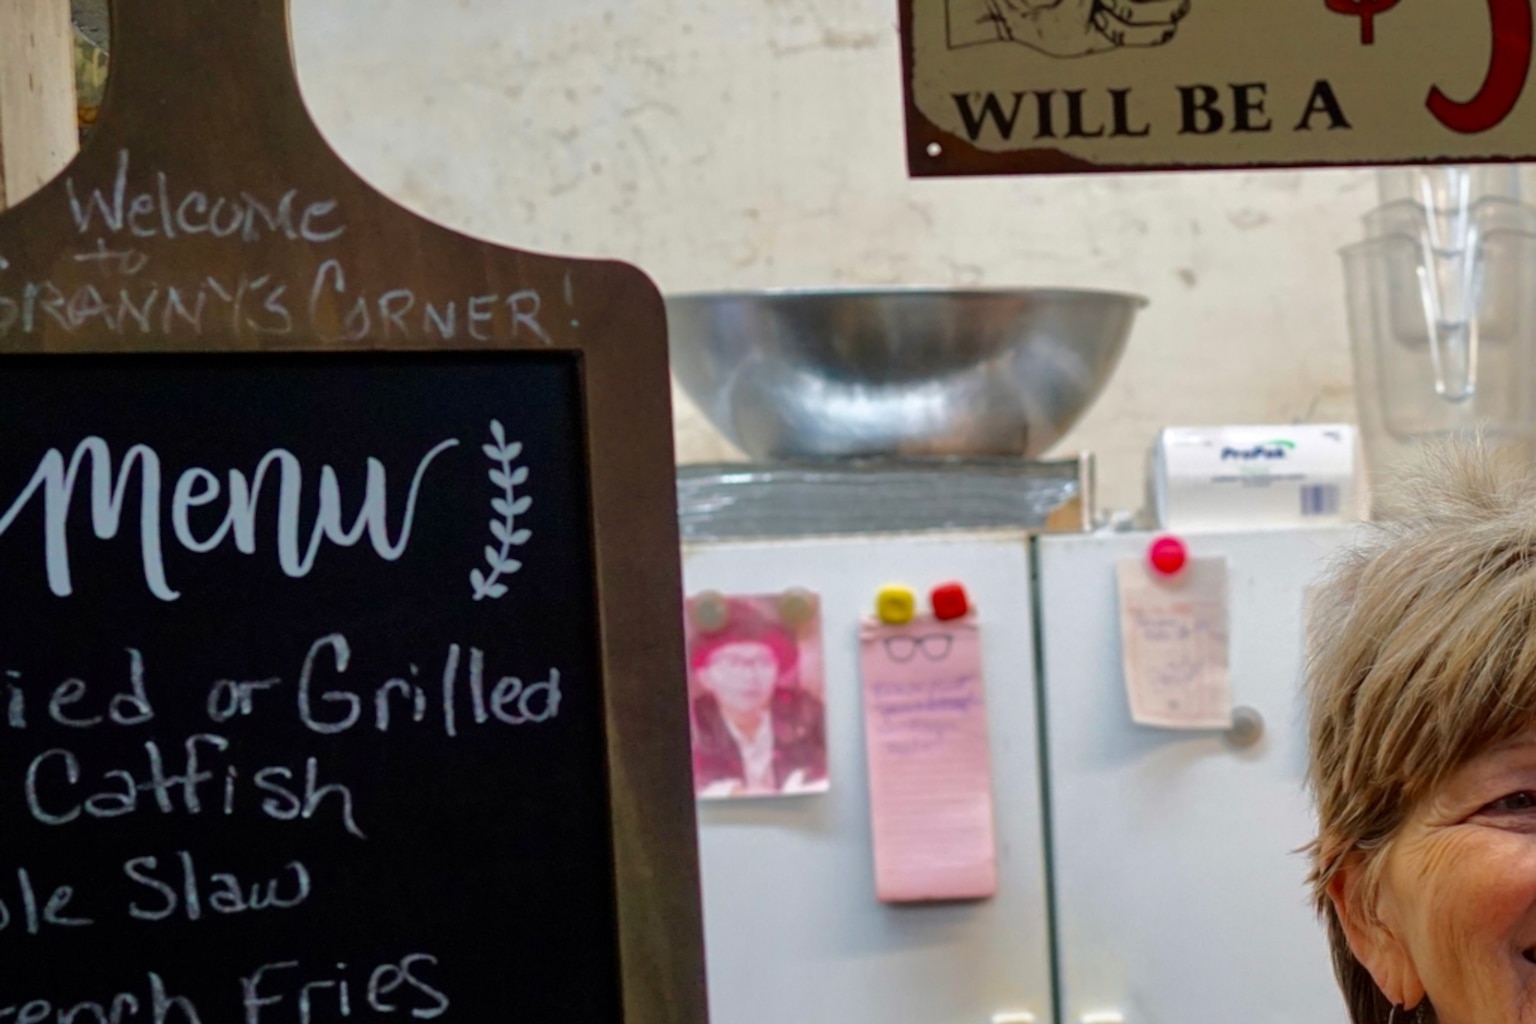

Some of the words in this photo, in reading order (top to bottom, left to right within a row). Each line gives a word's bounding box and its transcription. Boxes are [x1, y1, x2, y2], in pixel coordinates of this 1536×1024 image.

[951, 88, 1151, 142] WILL
[1175, 83, 1273, 135] BE
[1294, 79, 1353, 131] A
[74, 237, 149, 276] to
[0, 436, 460, 601] Menu
[208, 677, 281, 716] or
[298, 633, 562, 736] Grilled
[25, 733, 367, 839] Catfish
